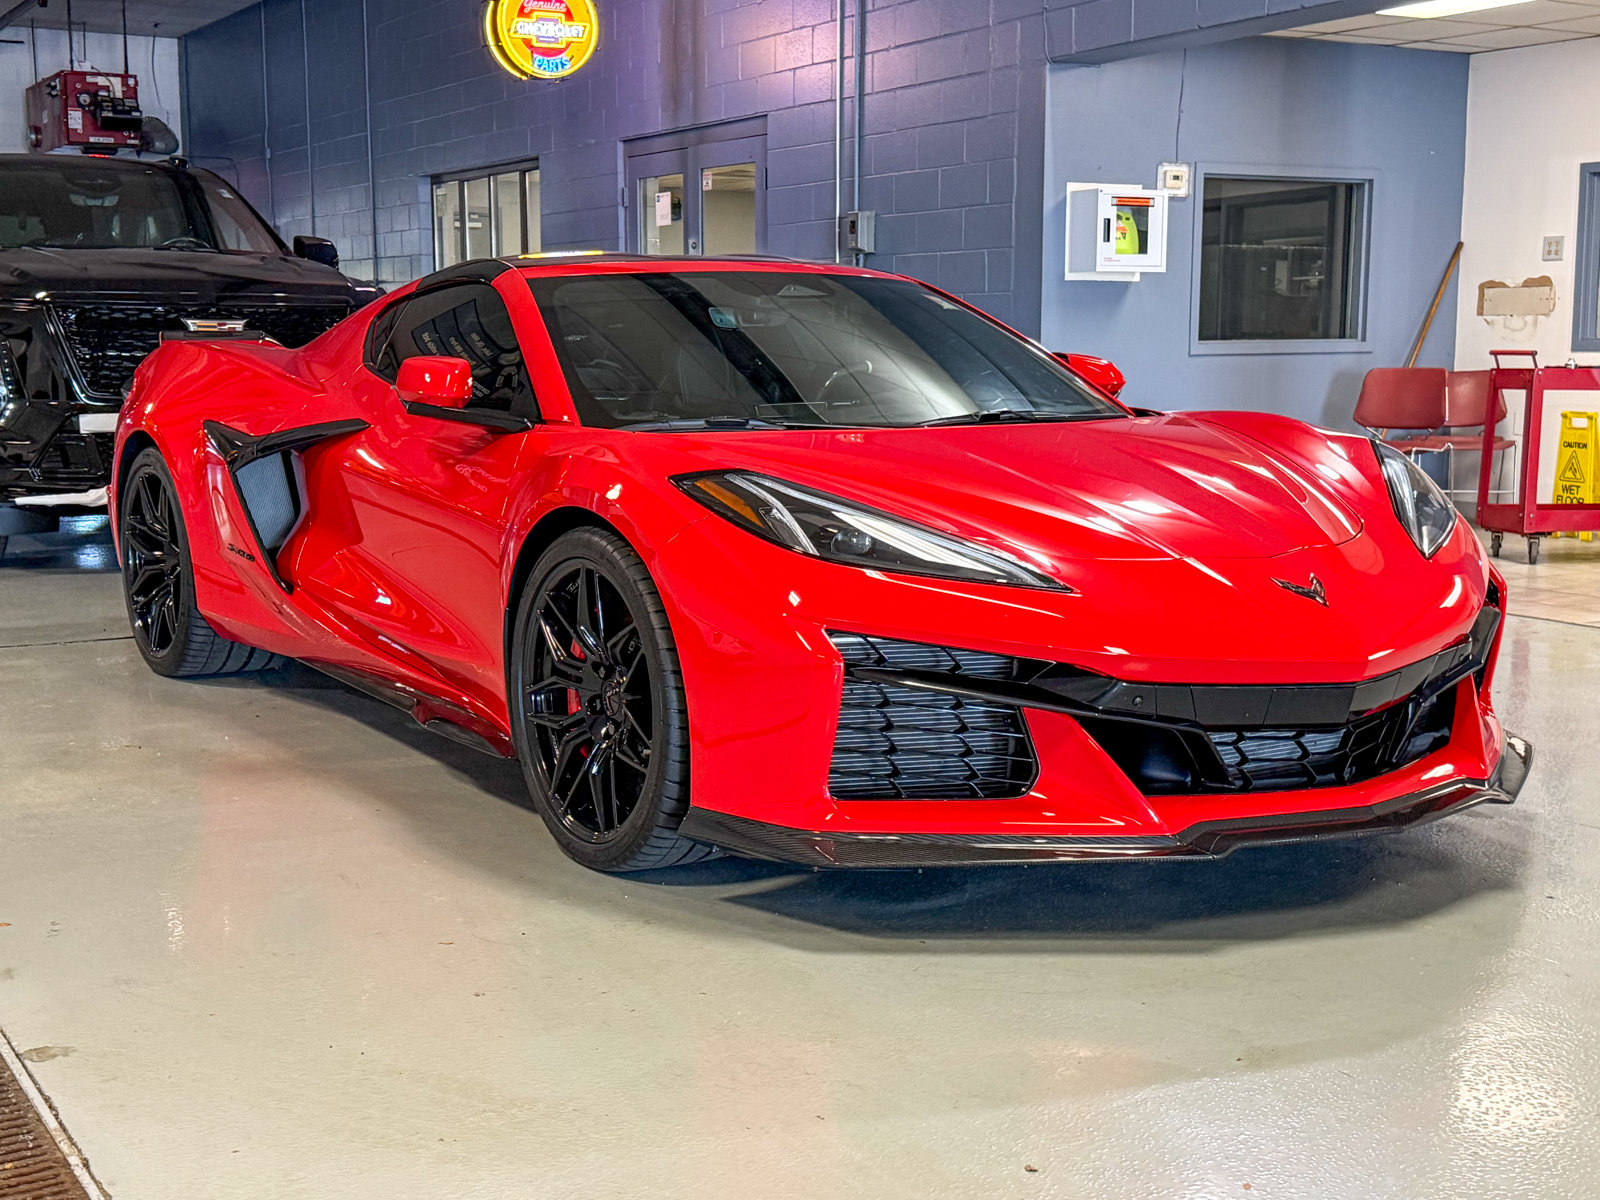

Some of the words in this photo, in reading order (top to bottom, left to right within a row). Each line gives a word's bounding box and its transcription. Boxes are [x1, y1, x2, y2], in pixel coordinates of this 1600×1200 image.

[516, 21, 585, 37] CHEVROLET
[535, 57, 571, 72] PARTS
[1562, 440, 1588, 449] CAUTION
[1562, 484, 1581, 495] WET
